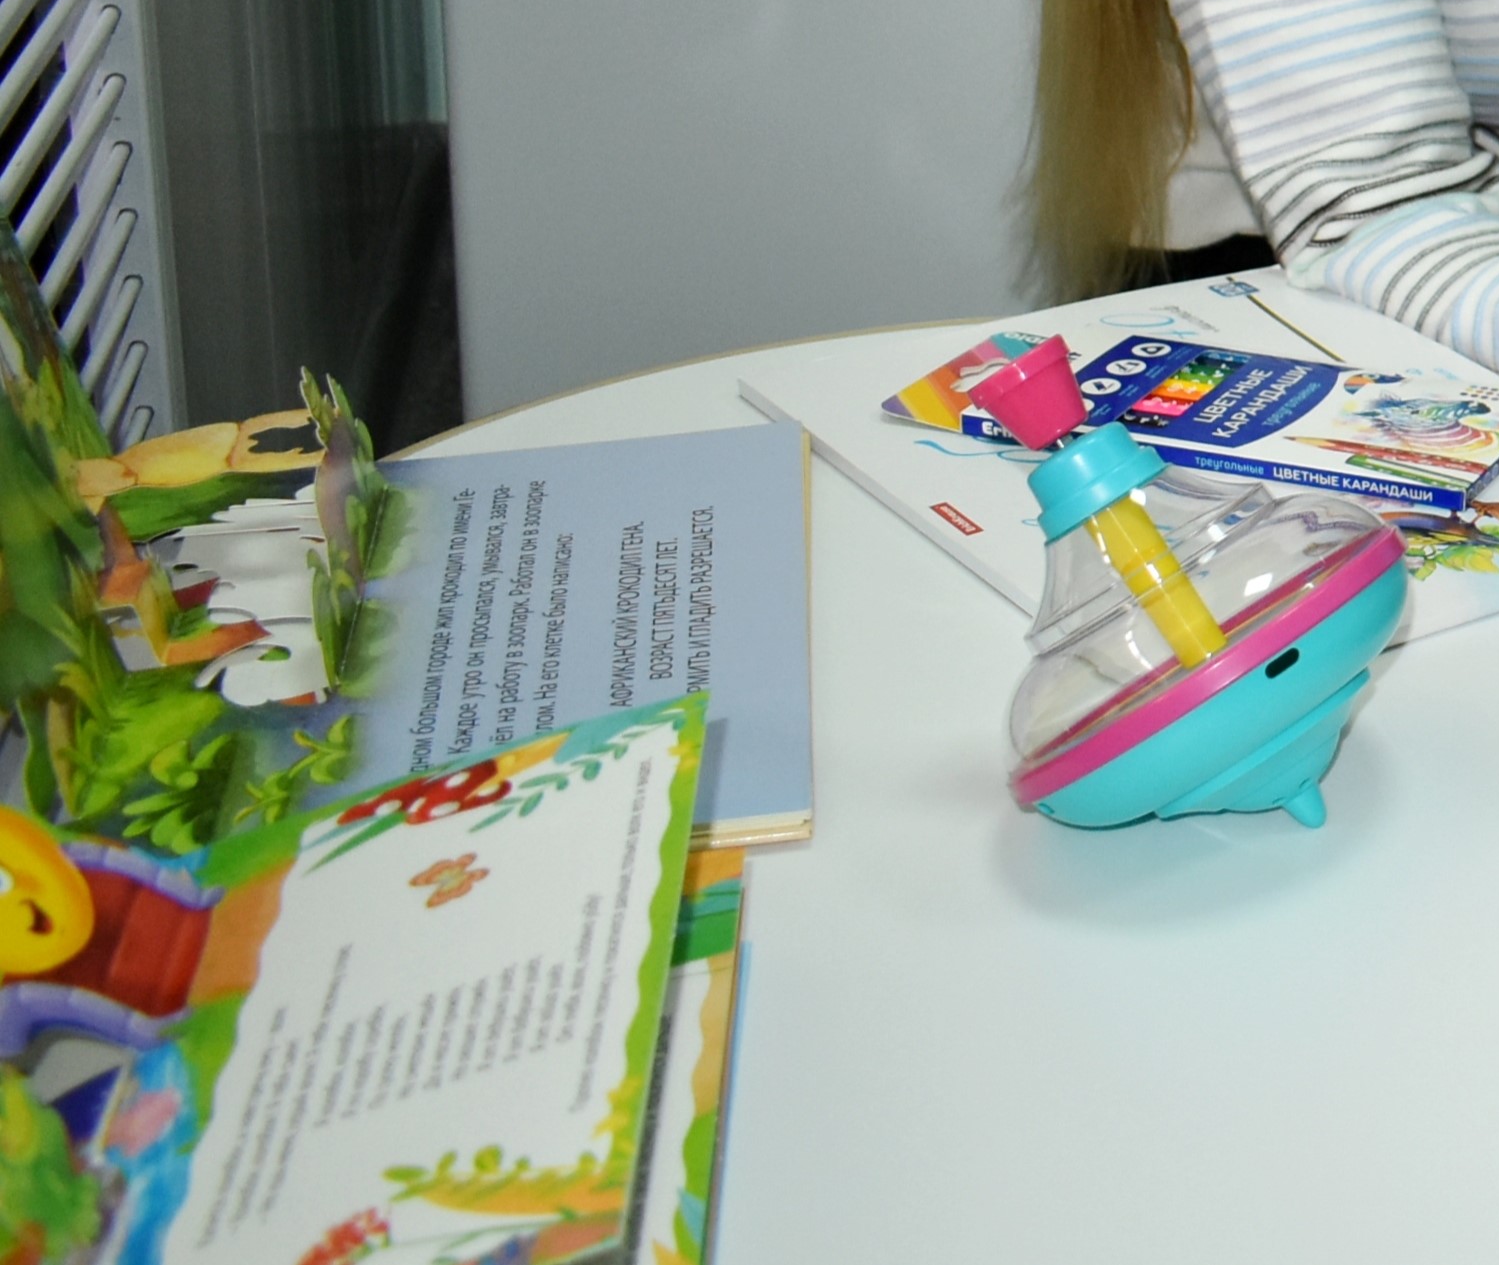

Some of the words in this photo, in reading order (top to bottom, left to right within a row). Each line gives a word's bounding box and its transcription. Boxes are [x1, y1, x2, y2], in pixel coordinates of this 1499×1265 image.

[1193, 369, 1273, 423] ЦВЕТНЫЕ
[1212, 365, 1313, 438] КАРАНДАШИ
[1195, 455, 1264, 475] треугольные
[1273, 466, 1339, 486] ЦВЕТНЫЕ
[1343, 478, 1433, 502] КАРАНДАШИ
[453, 503, 473, 535] имени
[524, 480, 549, 527] зоопарке
[450, 536, 467, 550] по
[481, 522, 508, 576] умывался,
[521, 538, 537, 551] он
[621, 521, 644, 552] ГЕНА.
[656, 537, 678, 559] ЛЕТ.
[690, 506, 714, 584] РАЗРЕШАЕТСЯ.
[440, 554, 466, 605] крокодил
[508, 554, 536, 596] Работал
[553, 533, 574, 586] написано:
[542, 588, 568, 618] было
[616, 553, 646, 614] КРОКОДИЛ
[652, 562, 680, 626] ПЯТЬДЕСЯТ
[435, 606, 454, 629] жил
[470, 577, 499, 648] просыпался,
[507, 598, 534, 648] зоопарк.
[689, 586, 716, 638] ГЛАДИТЬ
[427, 632, 453, 673] городе
[467, 651, 485, 667] он
[506, 650, 523, 658] в
[545, 619, 564, 659] клетке
[649, 628, 675, 680] ВОЗРАСТ
[689, 638, 710, 649] И
[495, 661, 529, 703] работу
[541, 660, 560, 681] его
[610, 616, 638, 707] АФРИКАНСКИЙ
[410, 676, 443, 736] большом
[462, 670, 486, 700] утро
[533, 683, 558, 701] На
[447, 703, 480, 754] Каждое
[498, 707, 516, 723] на
[410, 738, 433, 772] дном
[489, 727, 514, 746] ёл
